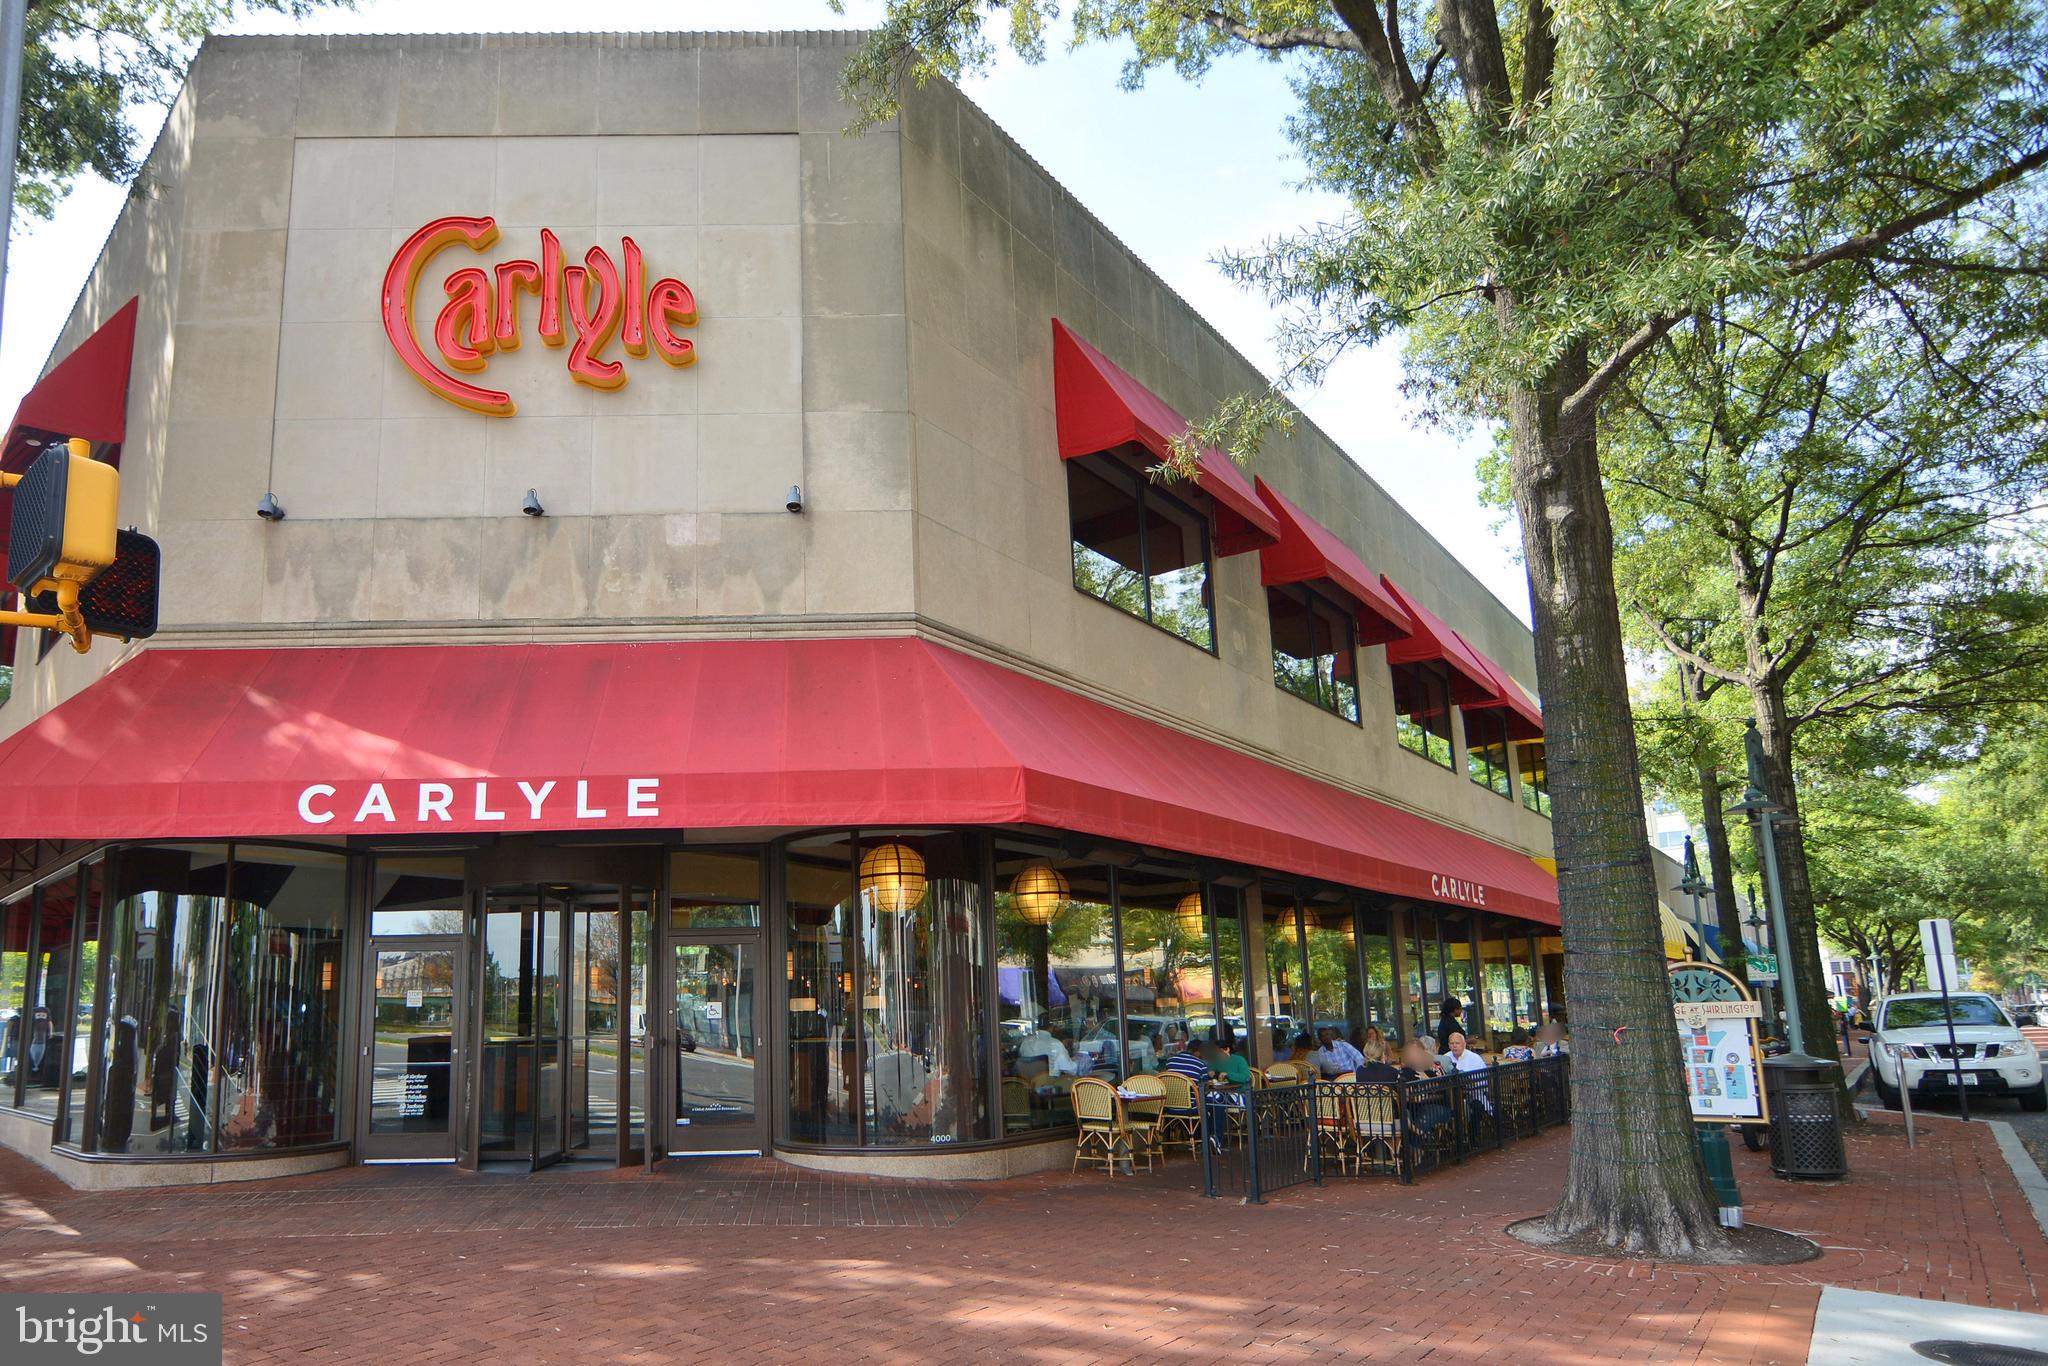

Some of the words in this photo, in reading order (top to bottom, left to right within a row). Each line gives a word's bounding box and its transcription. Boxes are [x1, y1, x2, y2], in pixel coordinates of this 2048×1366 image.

[381, 215, 699, 418] Carlyle
[297, 778, 660, 824] CARLYLE
[1431, 873, 1486, 906] CARLYLE
[1701, 1003, 1755, 1015] SHIRLINGTON
[930, 1134, 951, 1144] 4000
